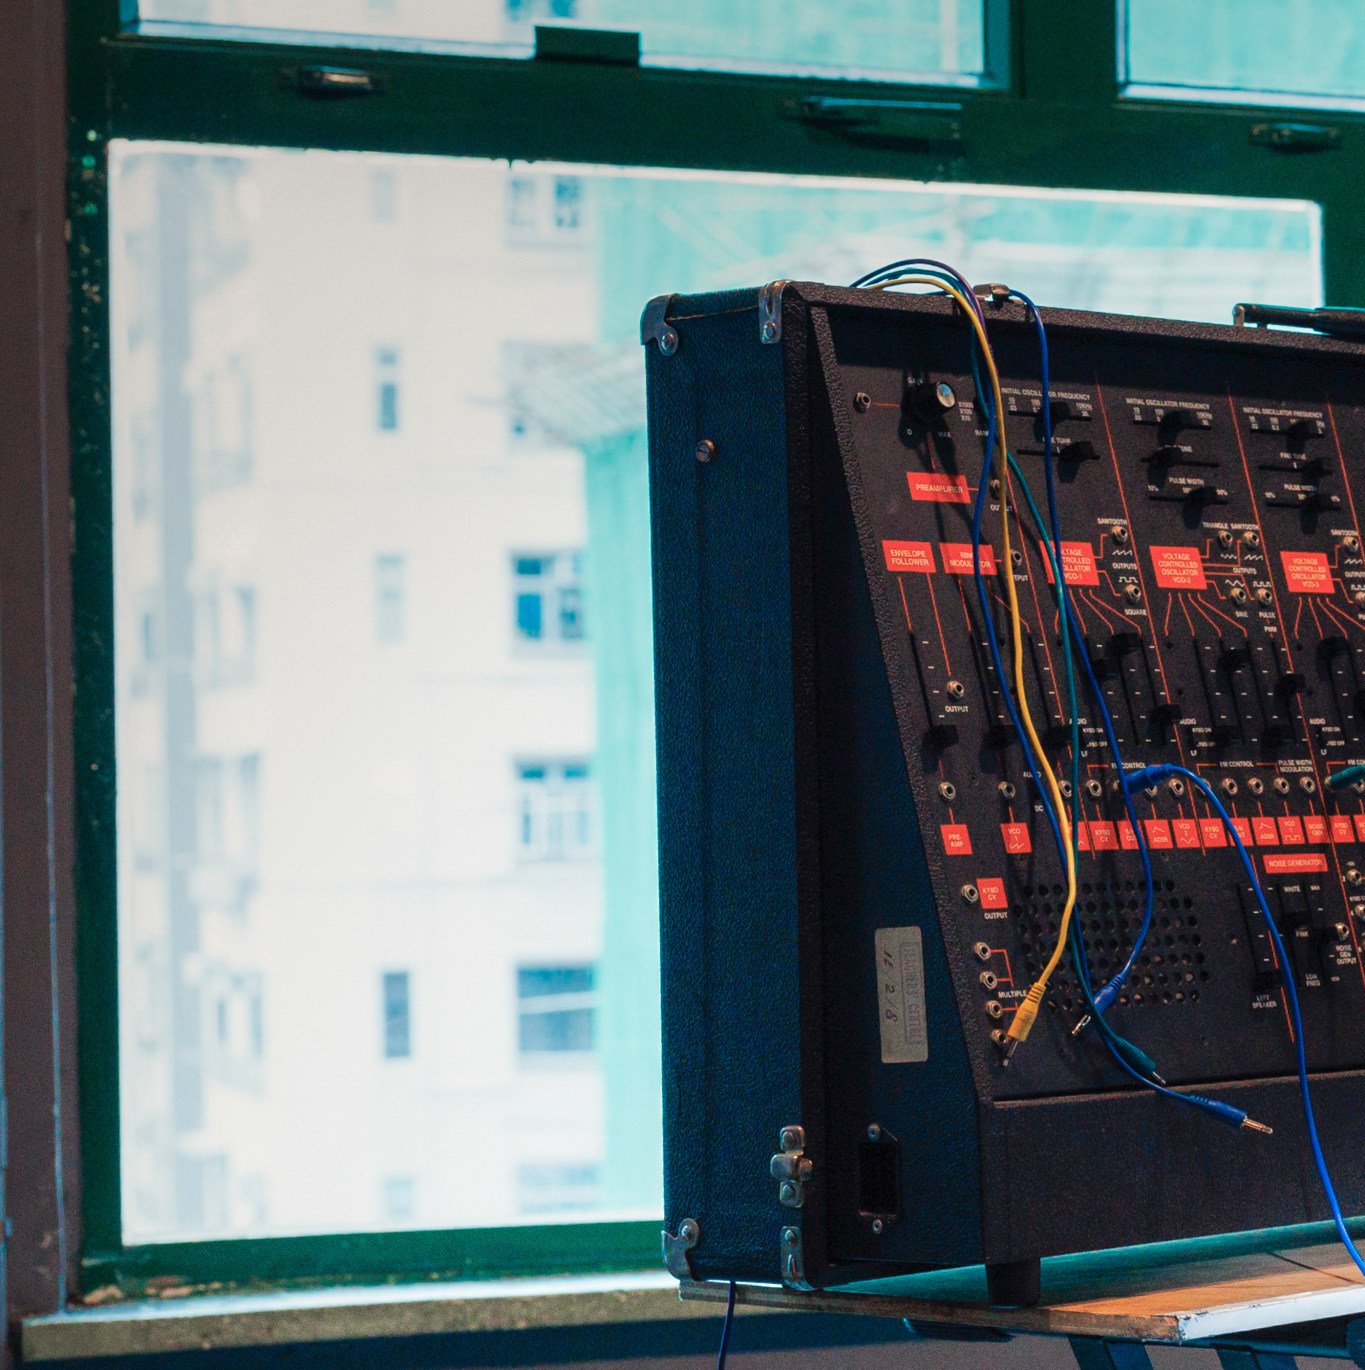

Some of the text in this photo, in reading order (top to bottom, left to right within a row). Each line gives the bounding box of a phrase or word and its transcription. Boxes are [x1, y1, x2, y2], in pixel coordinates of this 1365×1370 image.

[1021, 388, 1056, 397] OSCILLOR
[1057, 391, 1091, 400] FREQUENCY
[1148, 399, 1178, 408] OSCILLATOR
[1179, 401, 1210, 410] FREQUENCY
[916, 483, 964, 494] PREAMPLIFIER
[1097, 517, 1127, 526] SAWTOOTH
[1203, 521, 1259, 530] TRIANGLE SAWTOOTH
[890, 549, 926, 558] ENVELOPE
[1162, 553, 1190, 561] VOLTAGE
[891, 558, 929, 567] FOLLOWER
[949, 559, 991, 568] MODULOR
[1112, 562, 1137, 570] OUTPUTS
[1158, 561, 1198, 569] CONTROLLED
[1161, 568, 1199, 576] OSCILLATOR
[1233, 567, 1257, 575] OUTPUTS
[1289, 565, 1326, 573] CONTROLLED
[1172, 576, 1191, 584] VCO-2
[1291, 573, 1327, 581] OSCILLATOR
[1124, 608, 1147, 616] SQUARE
[944, 705, 969, 713] OUTPUT
[1287, 858, 1323, 866] GENERATOR
[1283, 885, 1301, 893] WHITE
[984, 912, 1008, 920] OUTPUT
[1336, 957, 1357, 965] OUTPUT
[998, 990, 1027, 999] MULTIPLE
